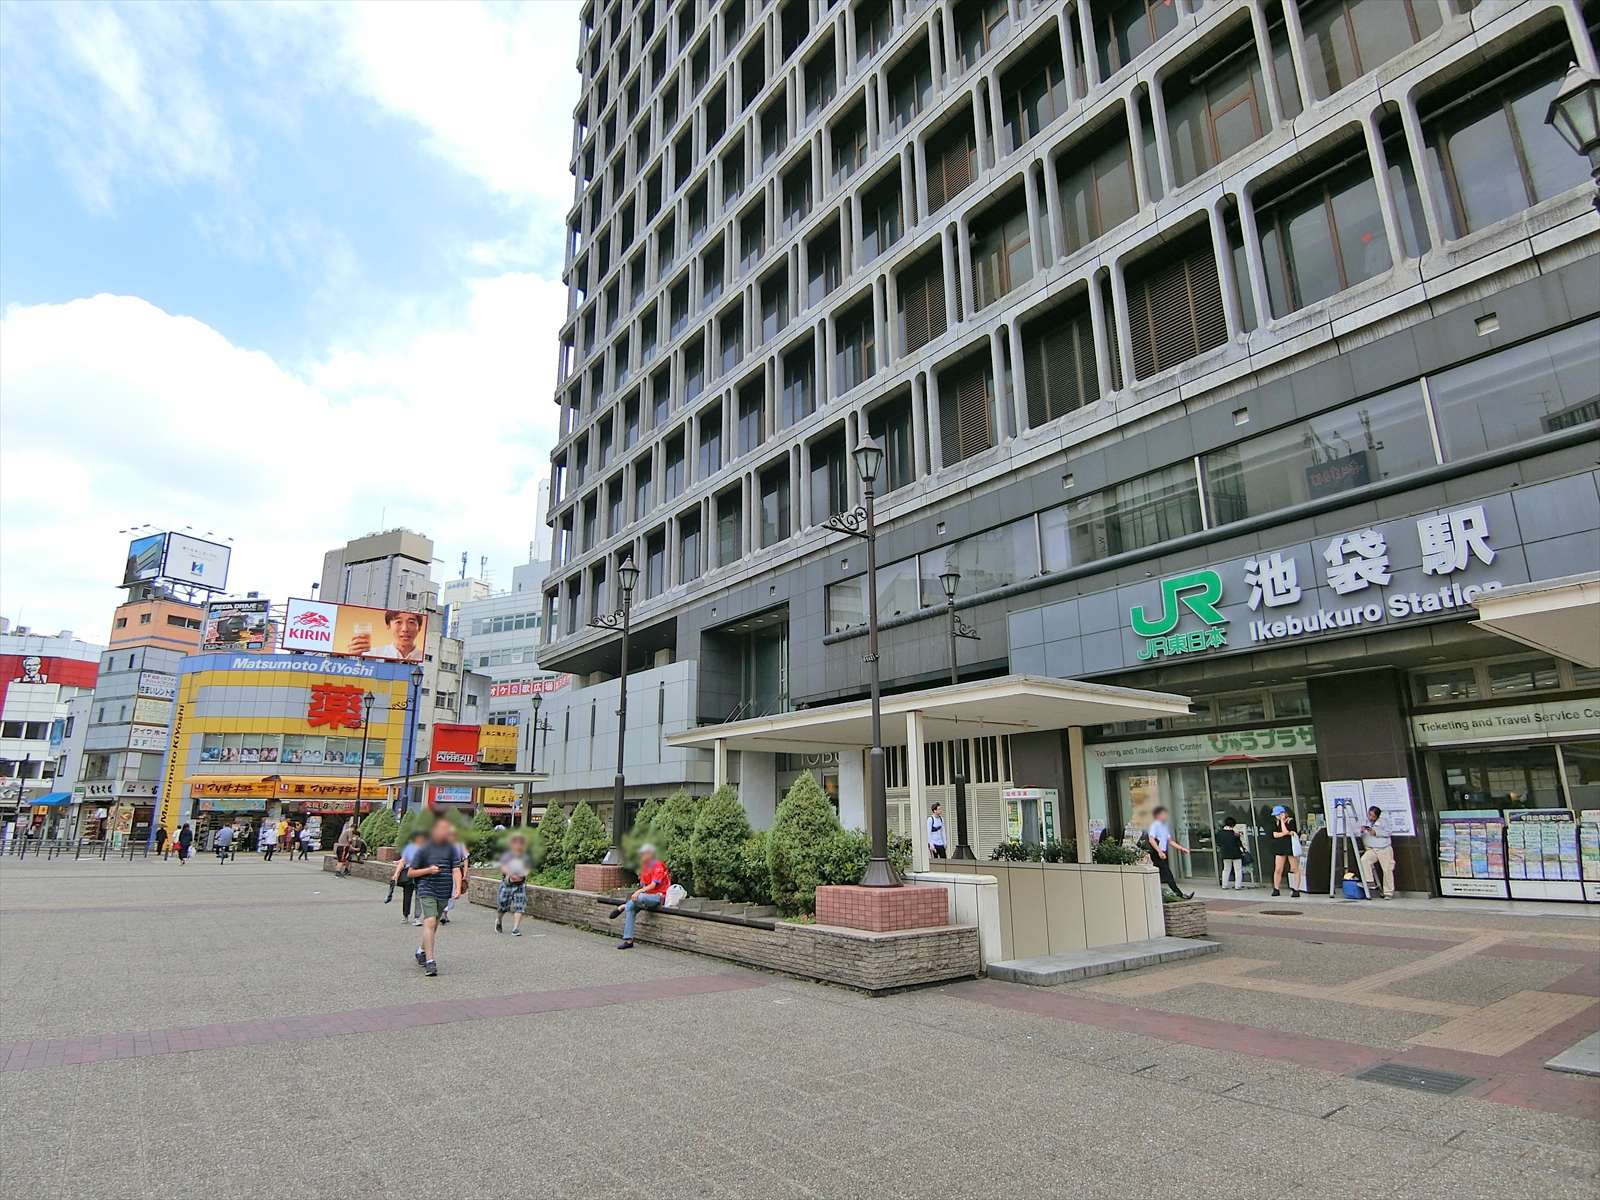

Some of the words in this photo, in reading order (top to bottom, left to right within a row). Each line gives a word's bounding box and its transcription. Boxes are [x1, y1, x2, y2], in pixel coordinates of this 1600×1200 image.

[1244, 505, 1496, 612] 池袋駅
[1130, 569, 1227, 637] JR
[289, 628, 331, 642] KIRIN
[1248, 602, 1384, 642] Ikebukuro
[1137, 626, 1227, 660] JR東日本
[232, 658, 318, 672] Matsumoto
[319, 661, 375, 676] KiYoshi
[522, 681, 553, 693] 歌広場
[307, 682, 364, 729] 薬
[1418, 720, 1469, 733] Ticketing
[1472, 717, 1493, 728] and
[1495, 714, 1531, 726] Travel
[1535, 710, 1580, 723] Service
[160, 748, 177, 824] Matsumoto
[172, 704, 185, 748] KiYoshi
[1095, 749, 1121, 758] Ticketing
[1122, 748, 1134, 756] and
[1135, 746, 1154, 755] Travel
[1155, 745, 1179, 753] Service
[1180, 743, 1202, 751] Center
